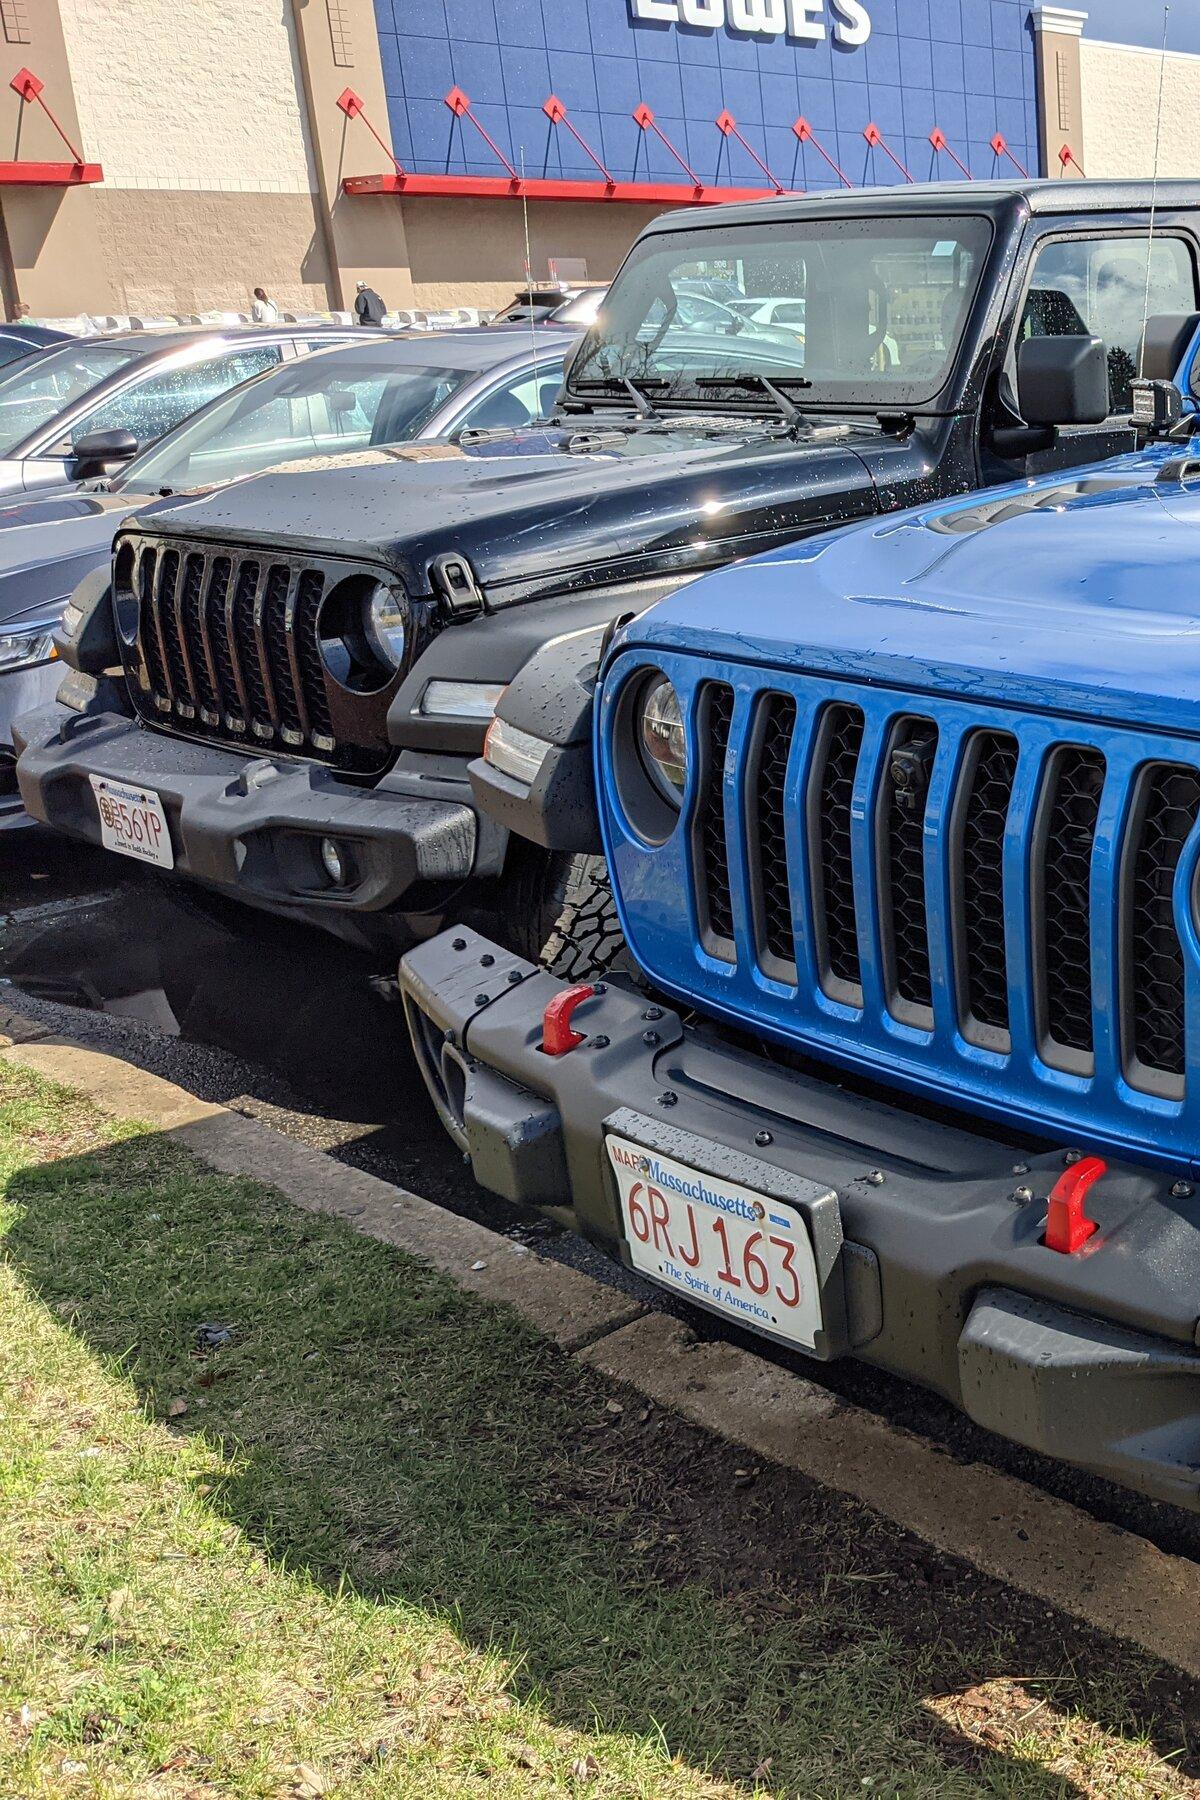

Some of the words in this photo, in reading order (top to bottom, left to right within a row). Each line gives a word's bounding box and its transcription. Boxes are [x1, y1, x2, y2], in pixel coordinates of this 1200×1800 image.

[646, 1155, 758, 1222] Massachusetts
[628, 1181, 700, 1267] 6RJ
[712, 1216, 800, 1308] 163
[664, 1260, 683, 1280] The
[684, 1269, 710, 1294] Spirit
[712, 1286, 723, 1301] of
[724, 1290, 770, 1320] America
